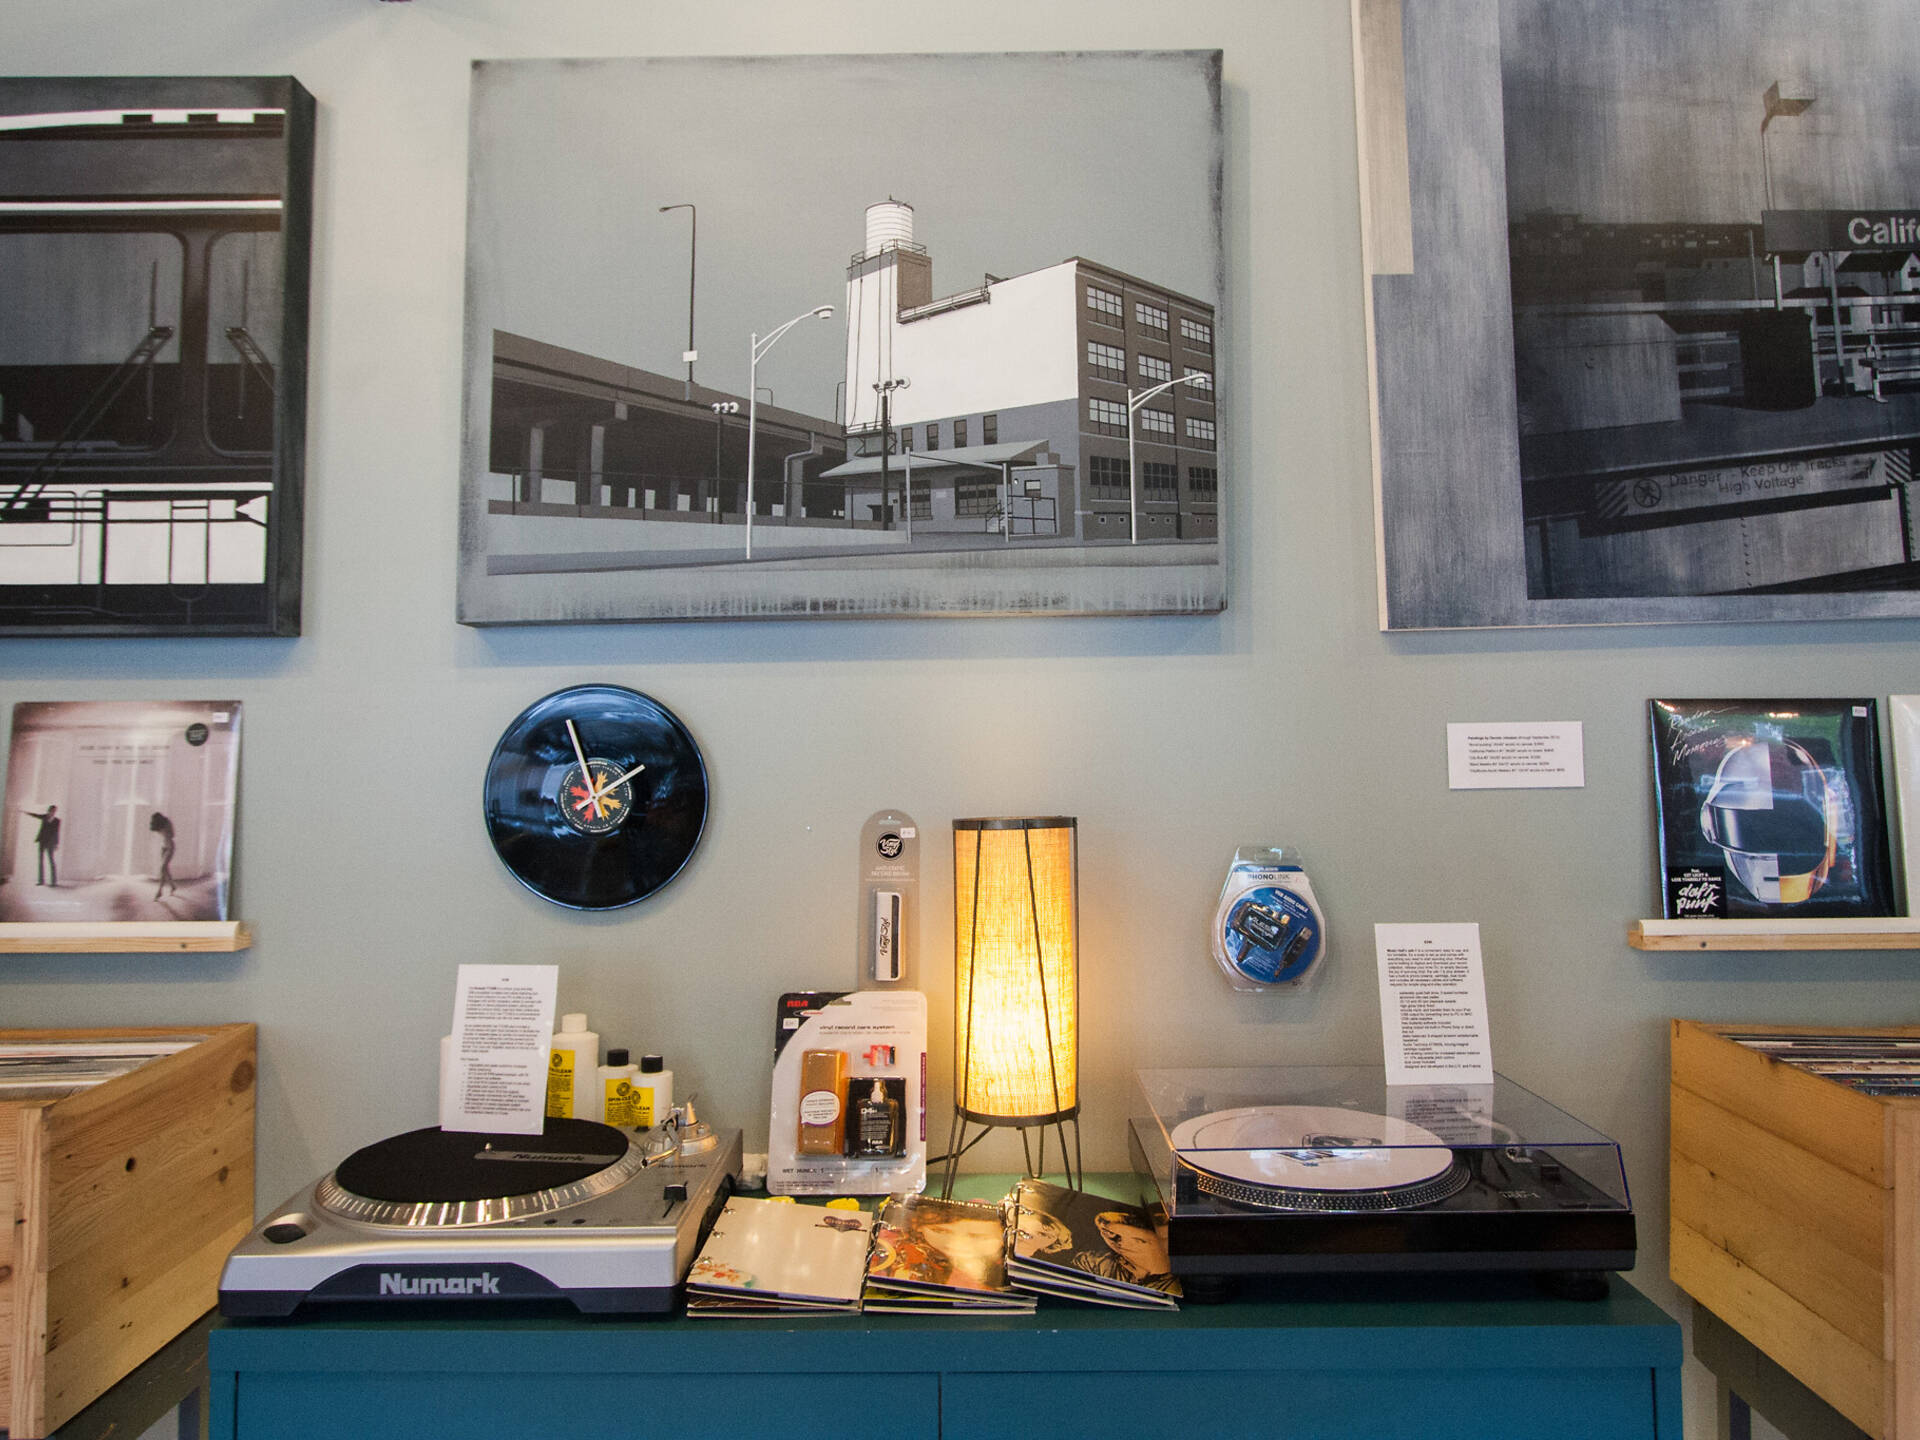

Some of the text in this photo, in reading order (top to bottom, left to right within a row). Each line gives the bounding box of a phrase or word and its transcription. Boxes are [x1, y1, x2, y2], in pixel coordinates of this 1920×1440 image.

[1848, 217, 1920, 245] Calif
[1668, 471, 1722, 488] Danger
[1739, 464, 1775, 480] Keep
[1719, 473, 1804, 495] High Voltage
[1678, 882, 1720, 899] daft
[1676, 892, 1720, 914] punk
[379, 1272, 500, 1295] Numark
